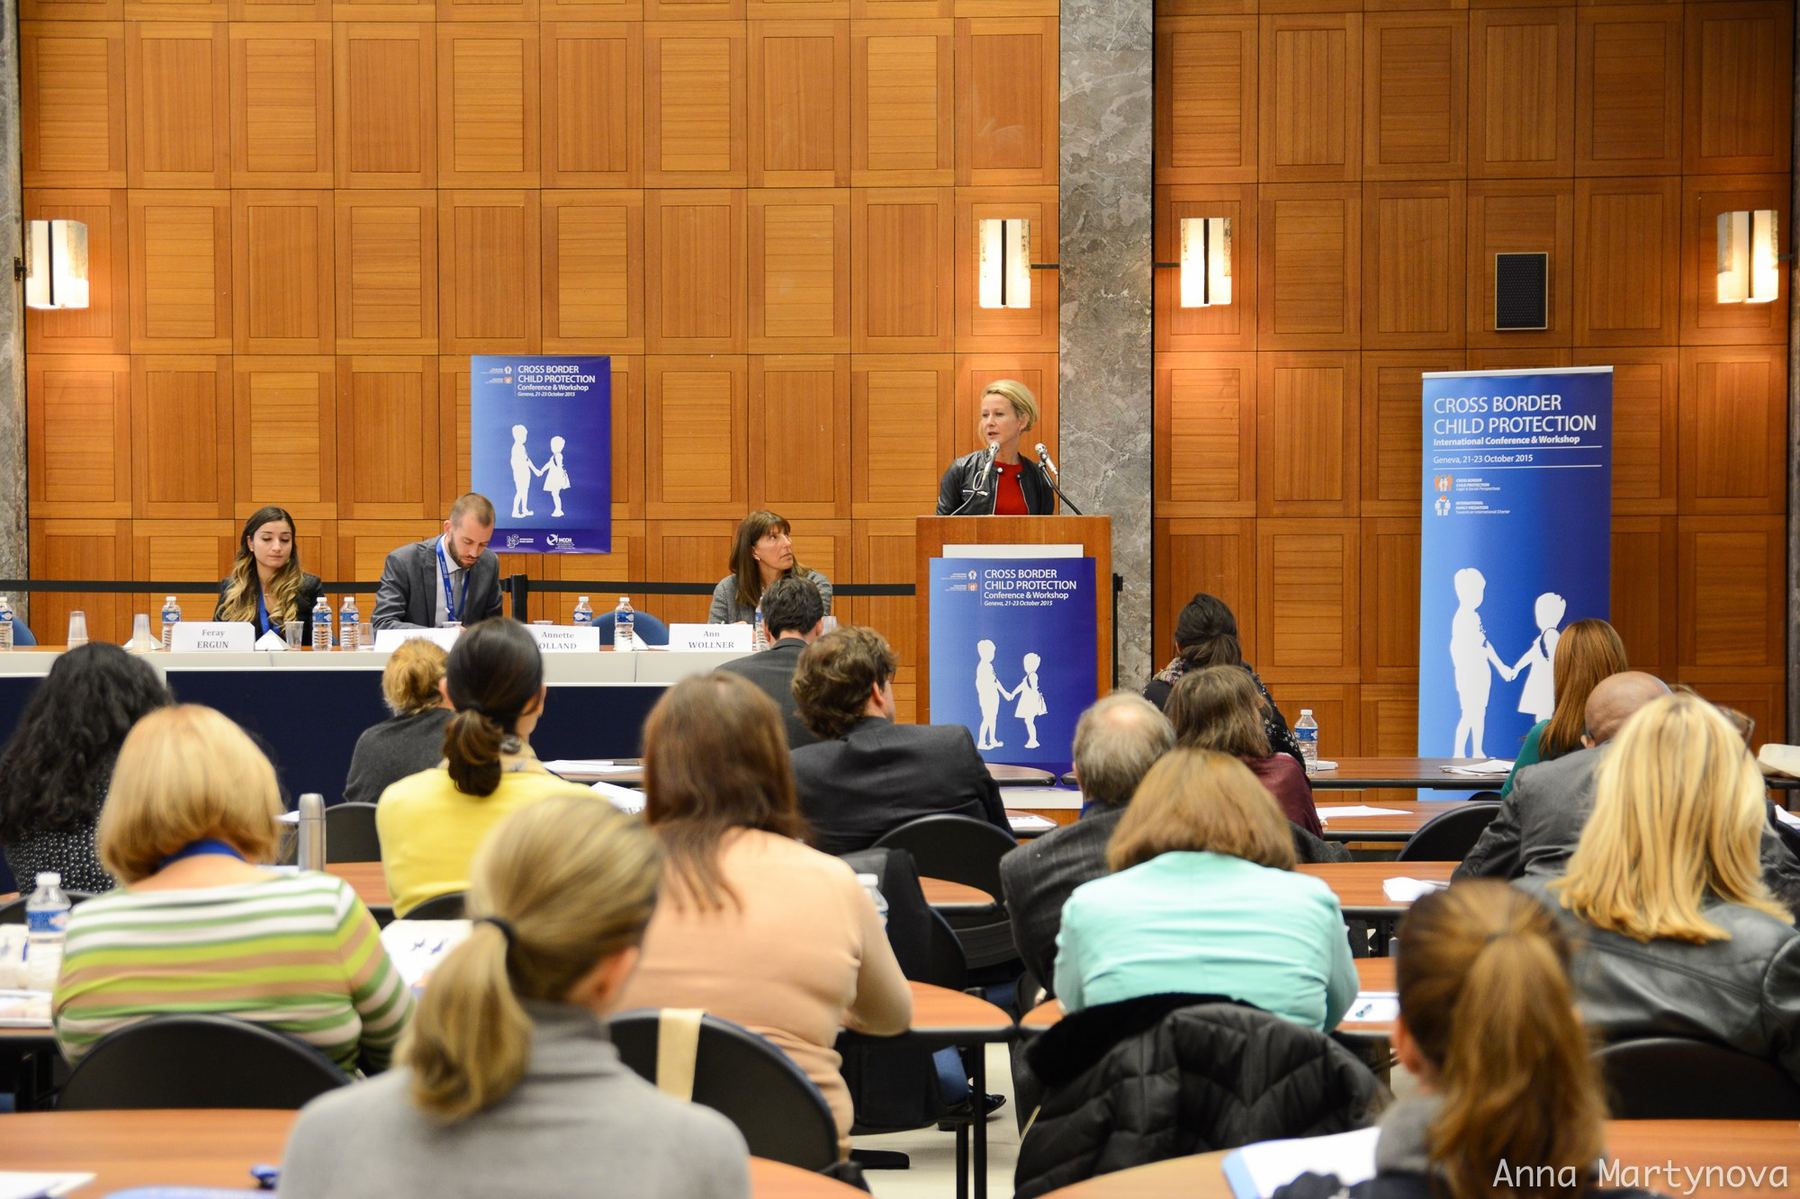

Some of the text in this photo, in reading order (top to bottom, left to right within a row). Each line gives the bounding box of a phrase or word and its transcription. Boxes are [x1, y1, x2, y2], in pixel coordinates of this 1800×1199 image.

[518, 365, 579, 374] CROSS BORDER
[518, 374, 596, 383] CHILD PROTECTION
[558, 384, 589, 392] Workshop
[1433, 394, 1562, 414] CROSS BORDER
[1433, 414, 1597, 435] CHILD PROTECTION
[1433, 435, 1580, 447] International Conference & Workshop
[1433, 454, 1533, 465] Geneva, 21-23 October 2015
[984, 569, 1057, 579] CROSS BORDER
[984, 580, 1077, 590] CHILD PROTECTION
[983, 591, 1069, 600] Conference & Workshop
[201, 629, 225, 638] Feray
[542, 631, 575, 639] Annette
[703, 630, 720, 638] Ann
[197, 641, 229, 649] ERGUN
[688, 641, 735, 649] WOLLNER
